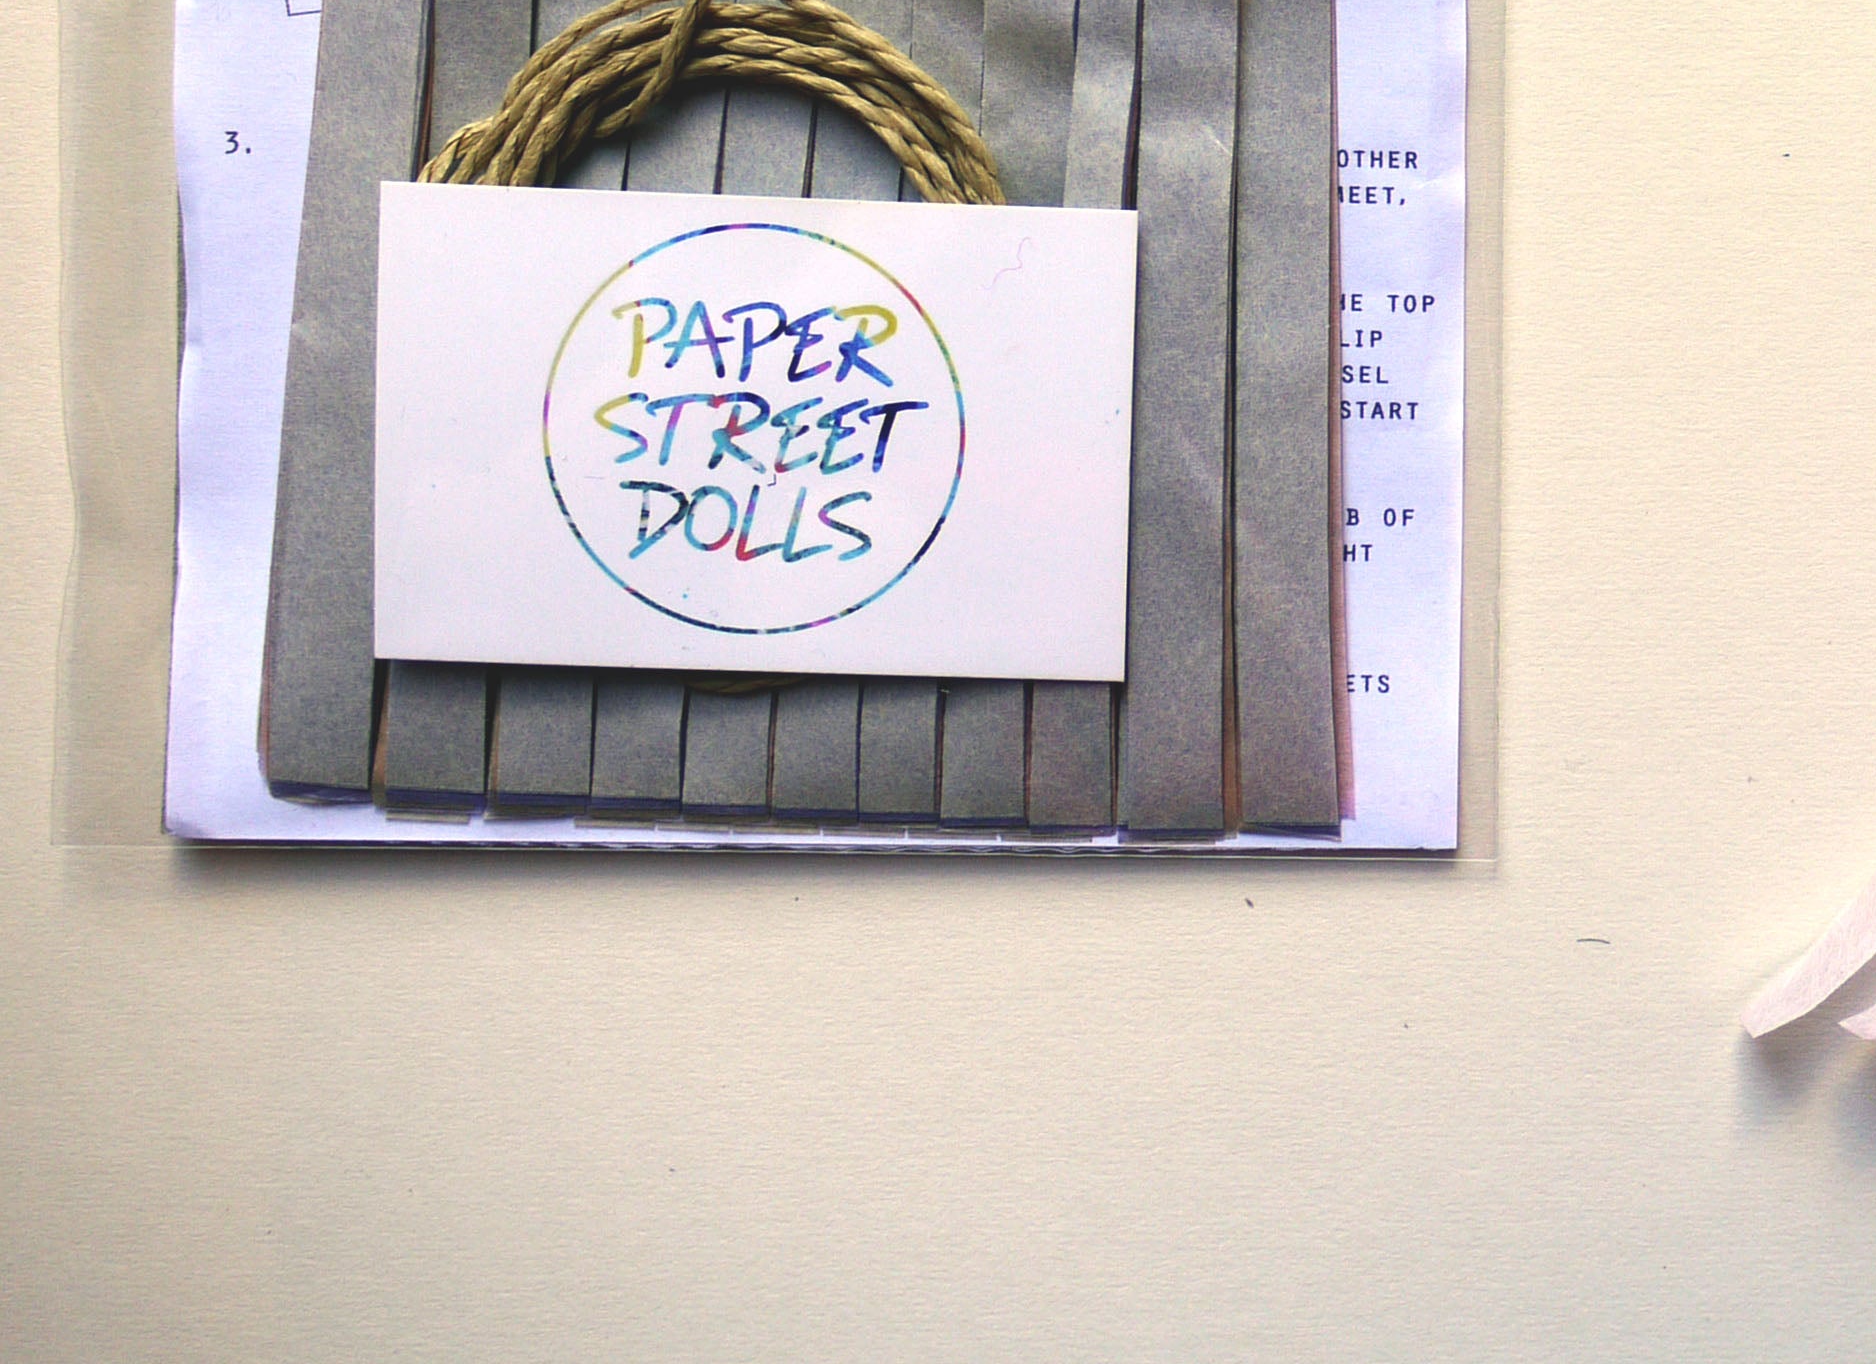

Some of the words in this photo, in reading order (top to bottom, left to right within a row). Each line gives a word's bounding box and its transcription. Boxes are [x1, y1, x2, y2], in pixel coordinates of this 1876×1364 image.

[224, 131, 253, 155] 3.
[1337, 149, 1418, 169] OTHER
[1387, 294, 1435, 313] TOP
[612, 296, 898, 387] PAPER
[1341, 400, 1419, 420] START
[594, 392, 930, 475] STREET
[619, 480, 873, 563] DOLLS
[1384, 508, 1415, 527] OF
